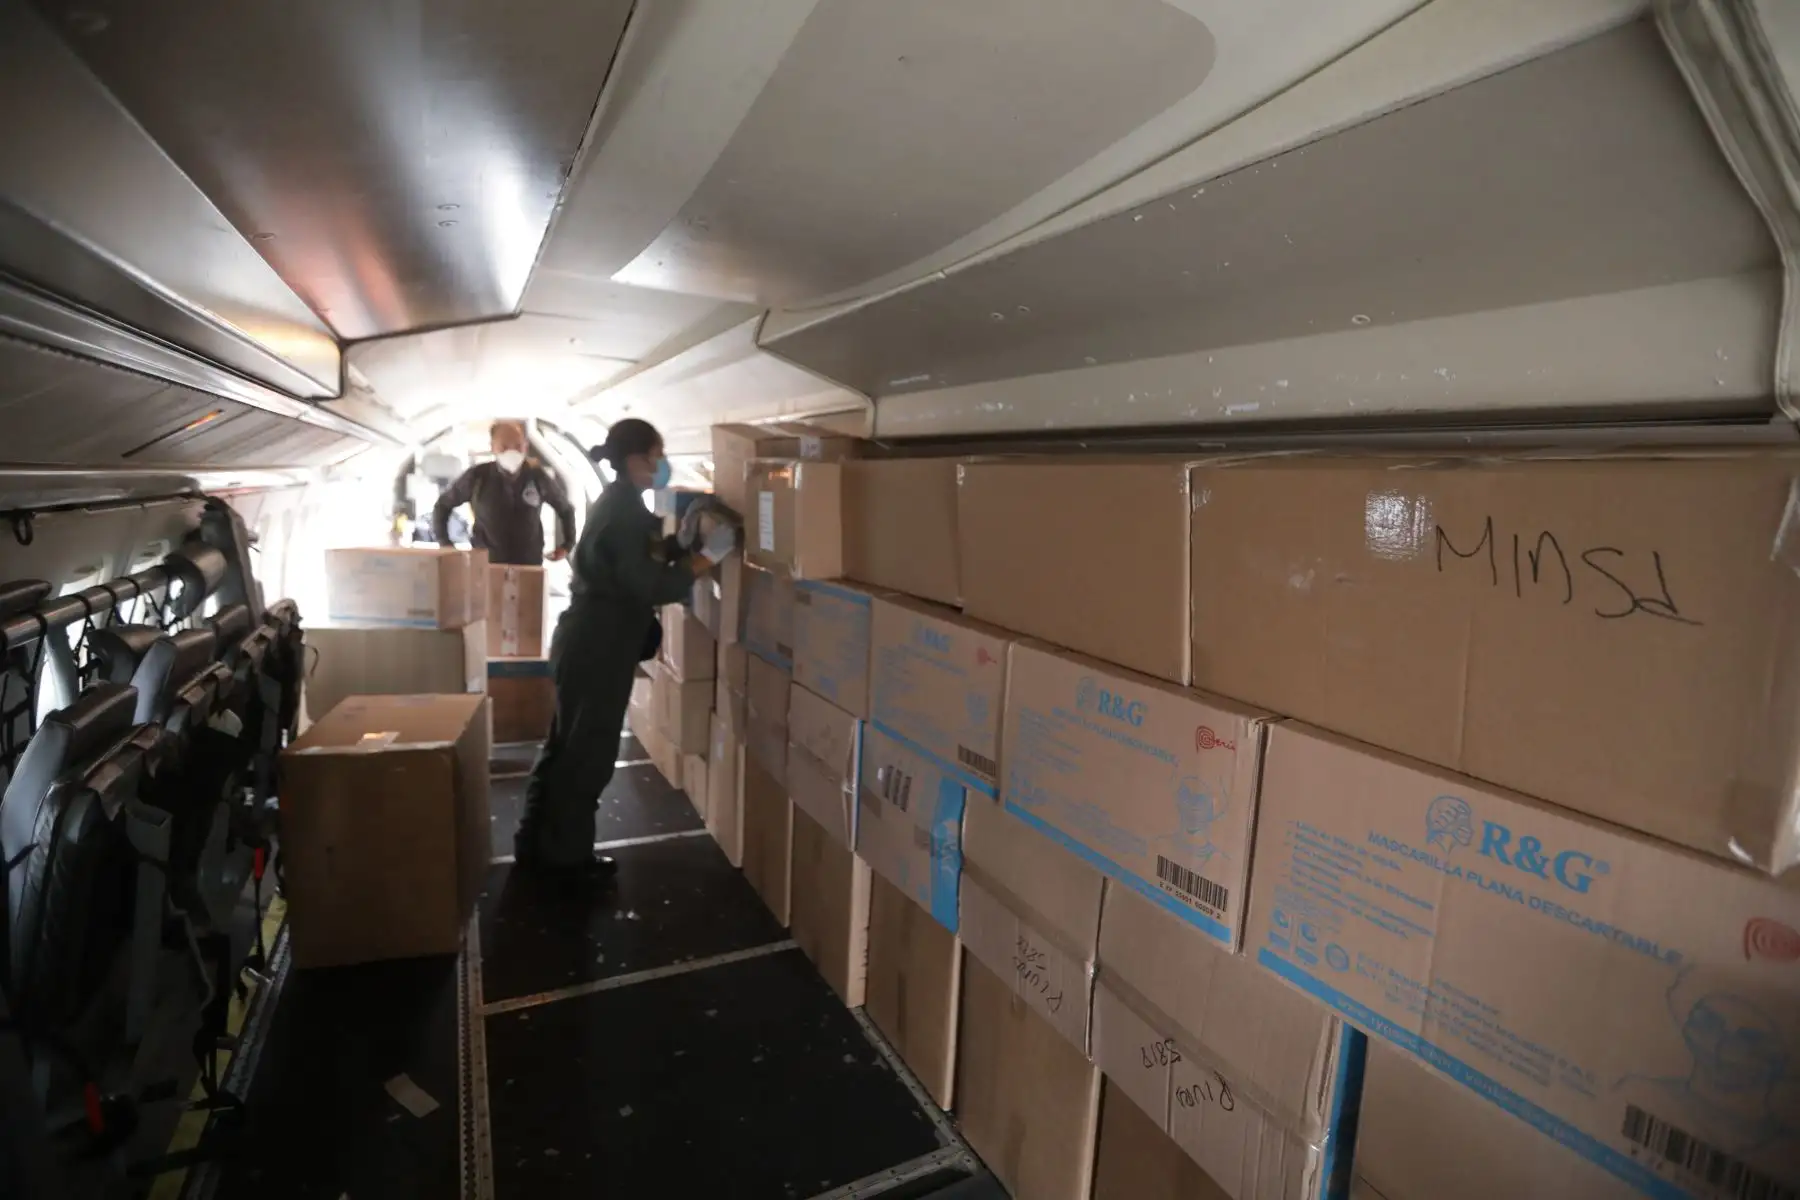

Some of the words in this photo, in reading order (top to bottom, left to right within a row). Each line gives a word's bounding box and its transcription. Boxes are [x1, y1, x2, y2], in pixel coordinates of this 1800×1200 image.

[1097, 687, 1146, 727] R&G
[1368, 829, 1463, 877] MASCARILLA
[1466, 870, 1526, 905] PLANA
[1528, 895, 1685, 966] DESCARTABLE
